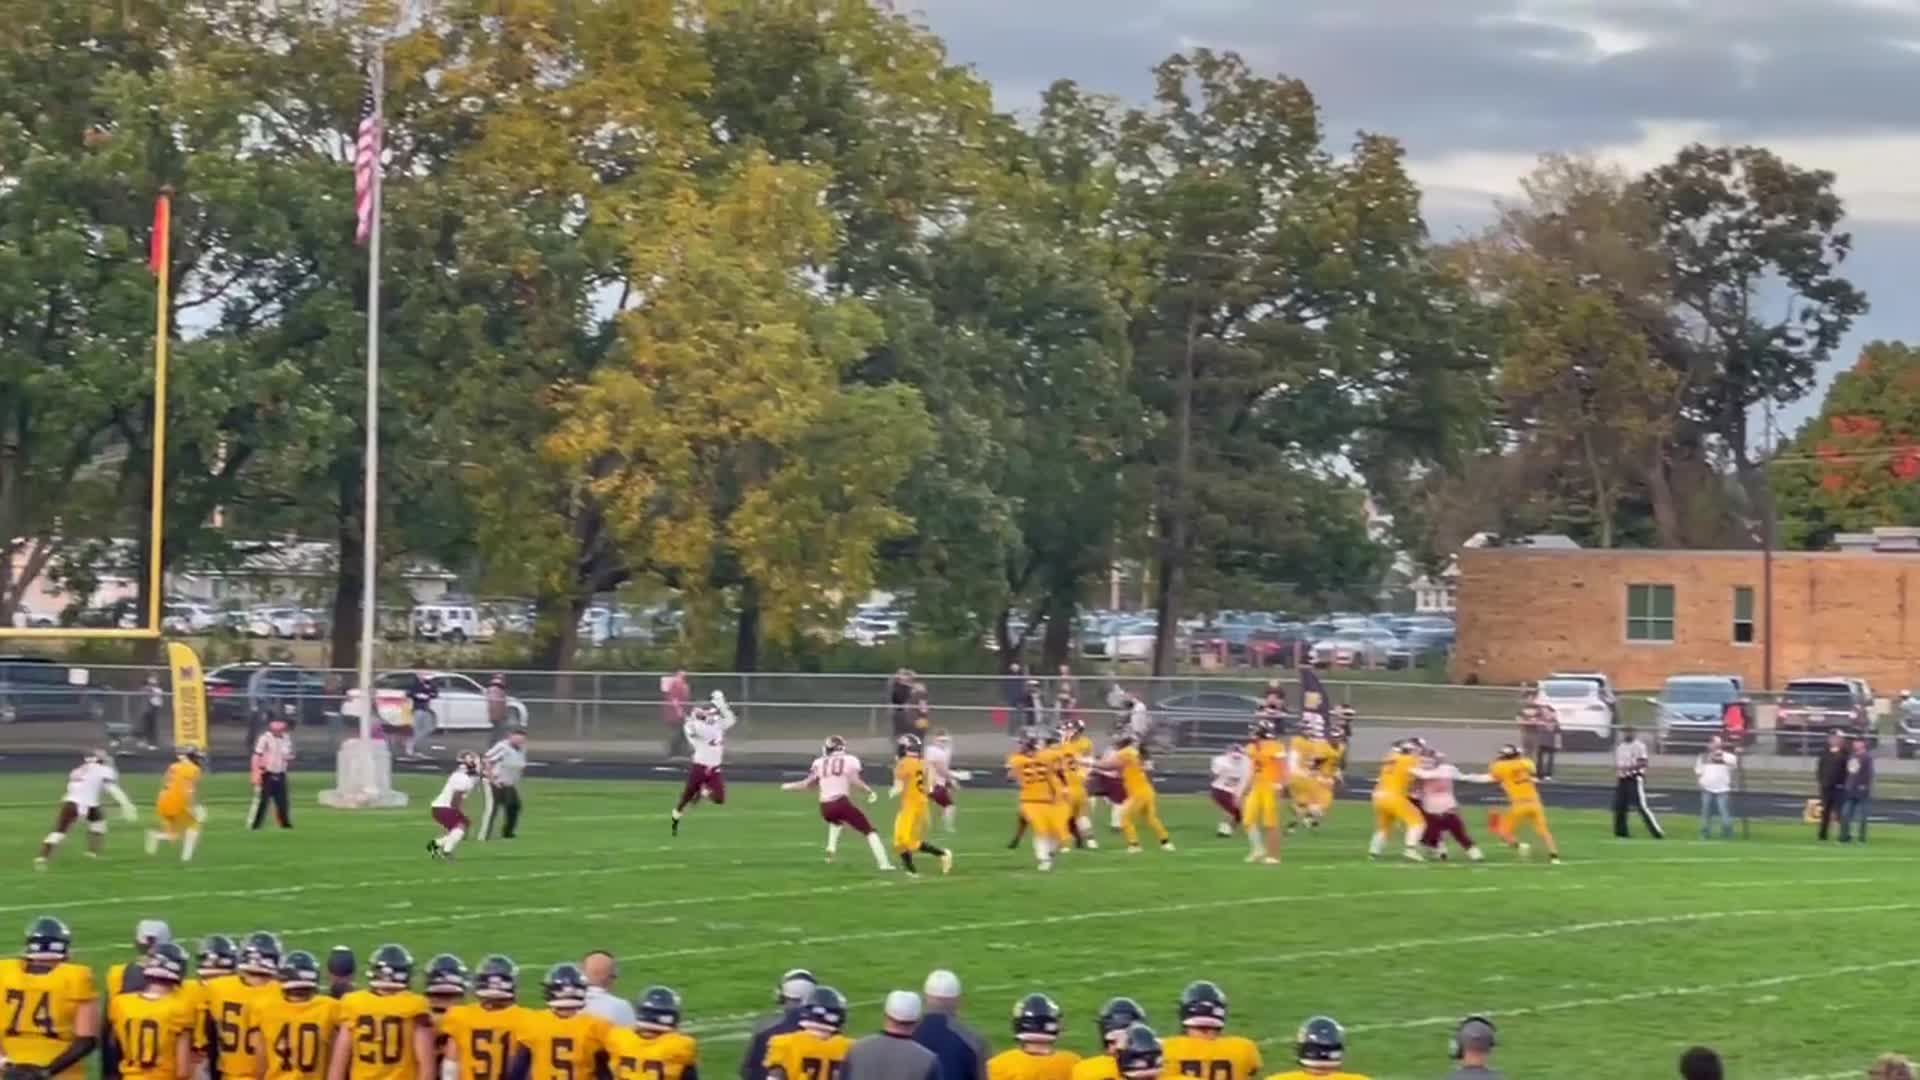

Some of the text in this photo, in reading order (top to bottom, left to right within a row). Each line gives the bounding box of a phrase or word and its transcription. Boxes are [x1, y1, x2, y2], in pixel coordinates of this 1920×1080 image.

[6, 989, 59, 1038] 74
[126, 1018, 158, 1068] 10
[274, 1022, 319, 1072] 40
[358, 1014, 403, 1064] 20
